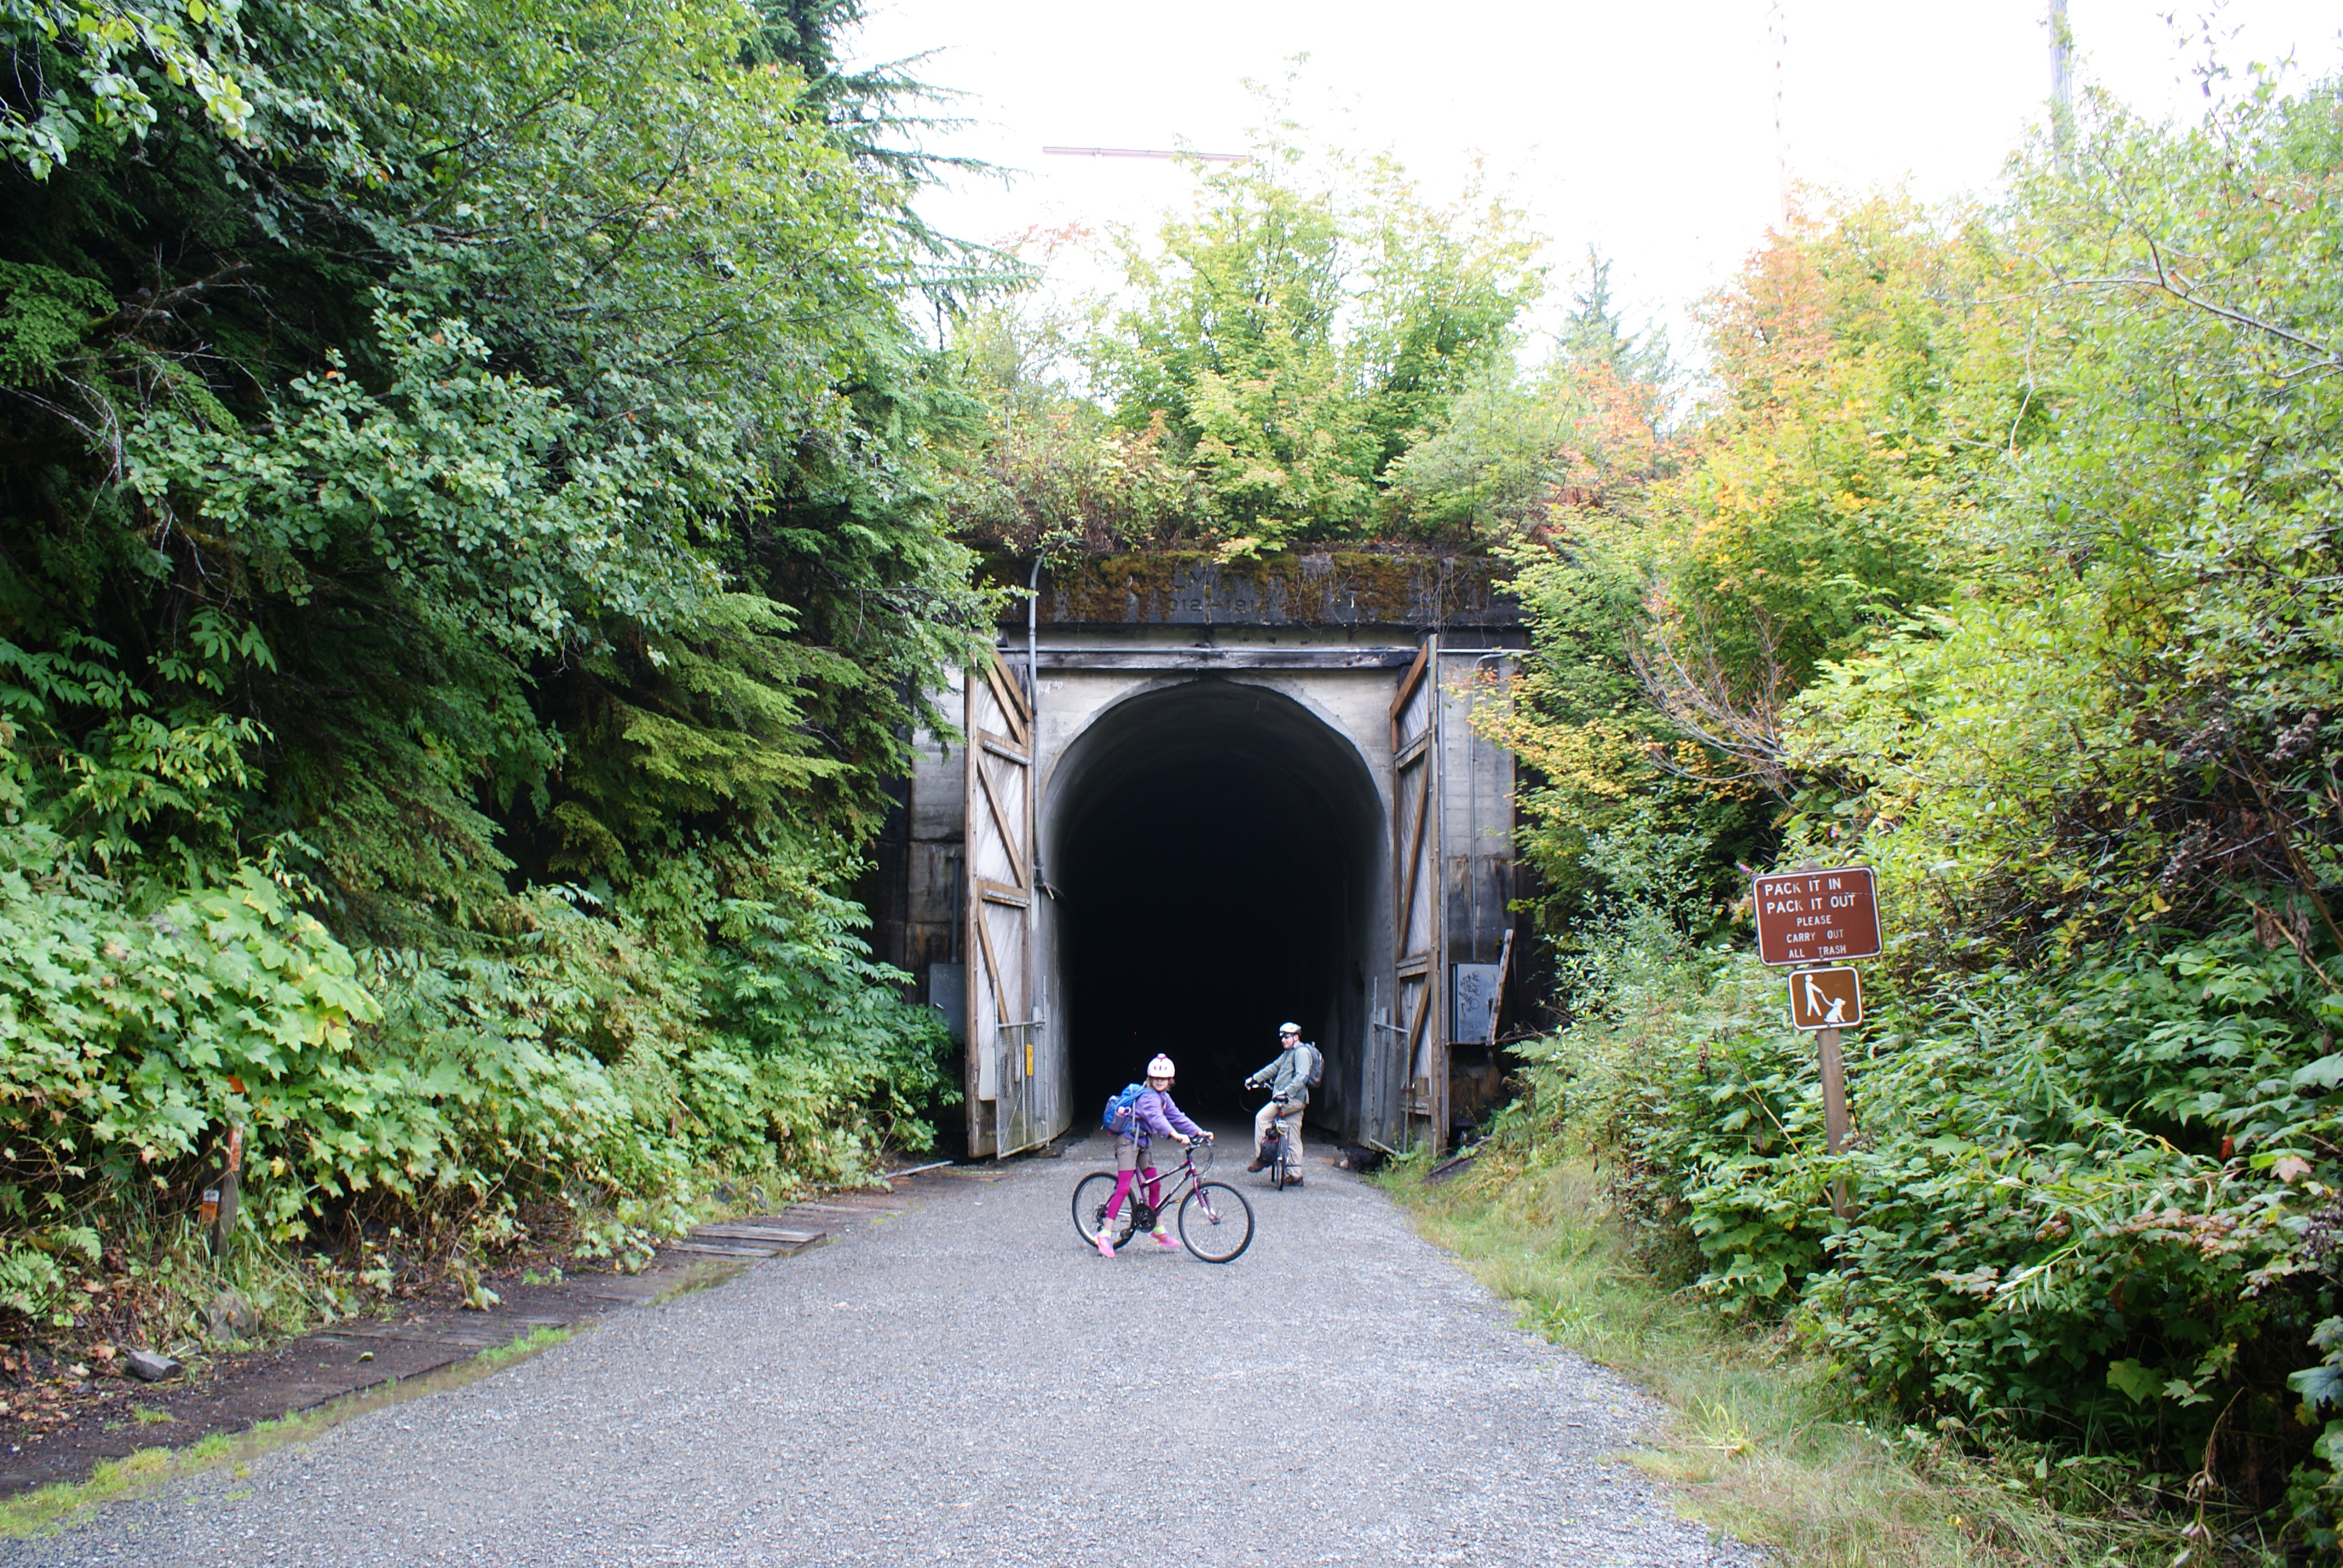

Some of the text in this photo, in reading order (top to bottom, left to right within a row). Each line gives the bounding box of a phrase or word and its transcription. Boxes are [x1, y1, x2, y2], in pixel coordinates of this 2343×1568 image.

[1765, 878, 1841, 897] PACK IT IN
[1766, 895, 1855, 914] PACK IT OUT
[1797, 915, 1832, 927] PLEASE
[1786, 929, 1844, 943] CARRY OUT
[1789, 944, 1847, 958] ALL TRASH
